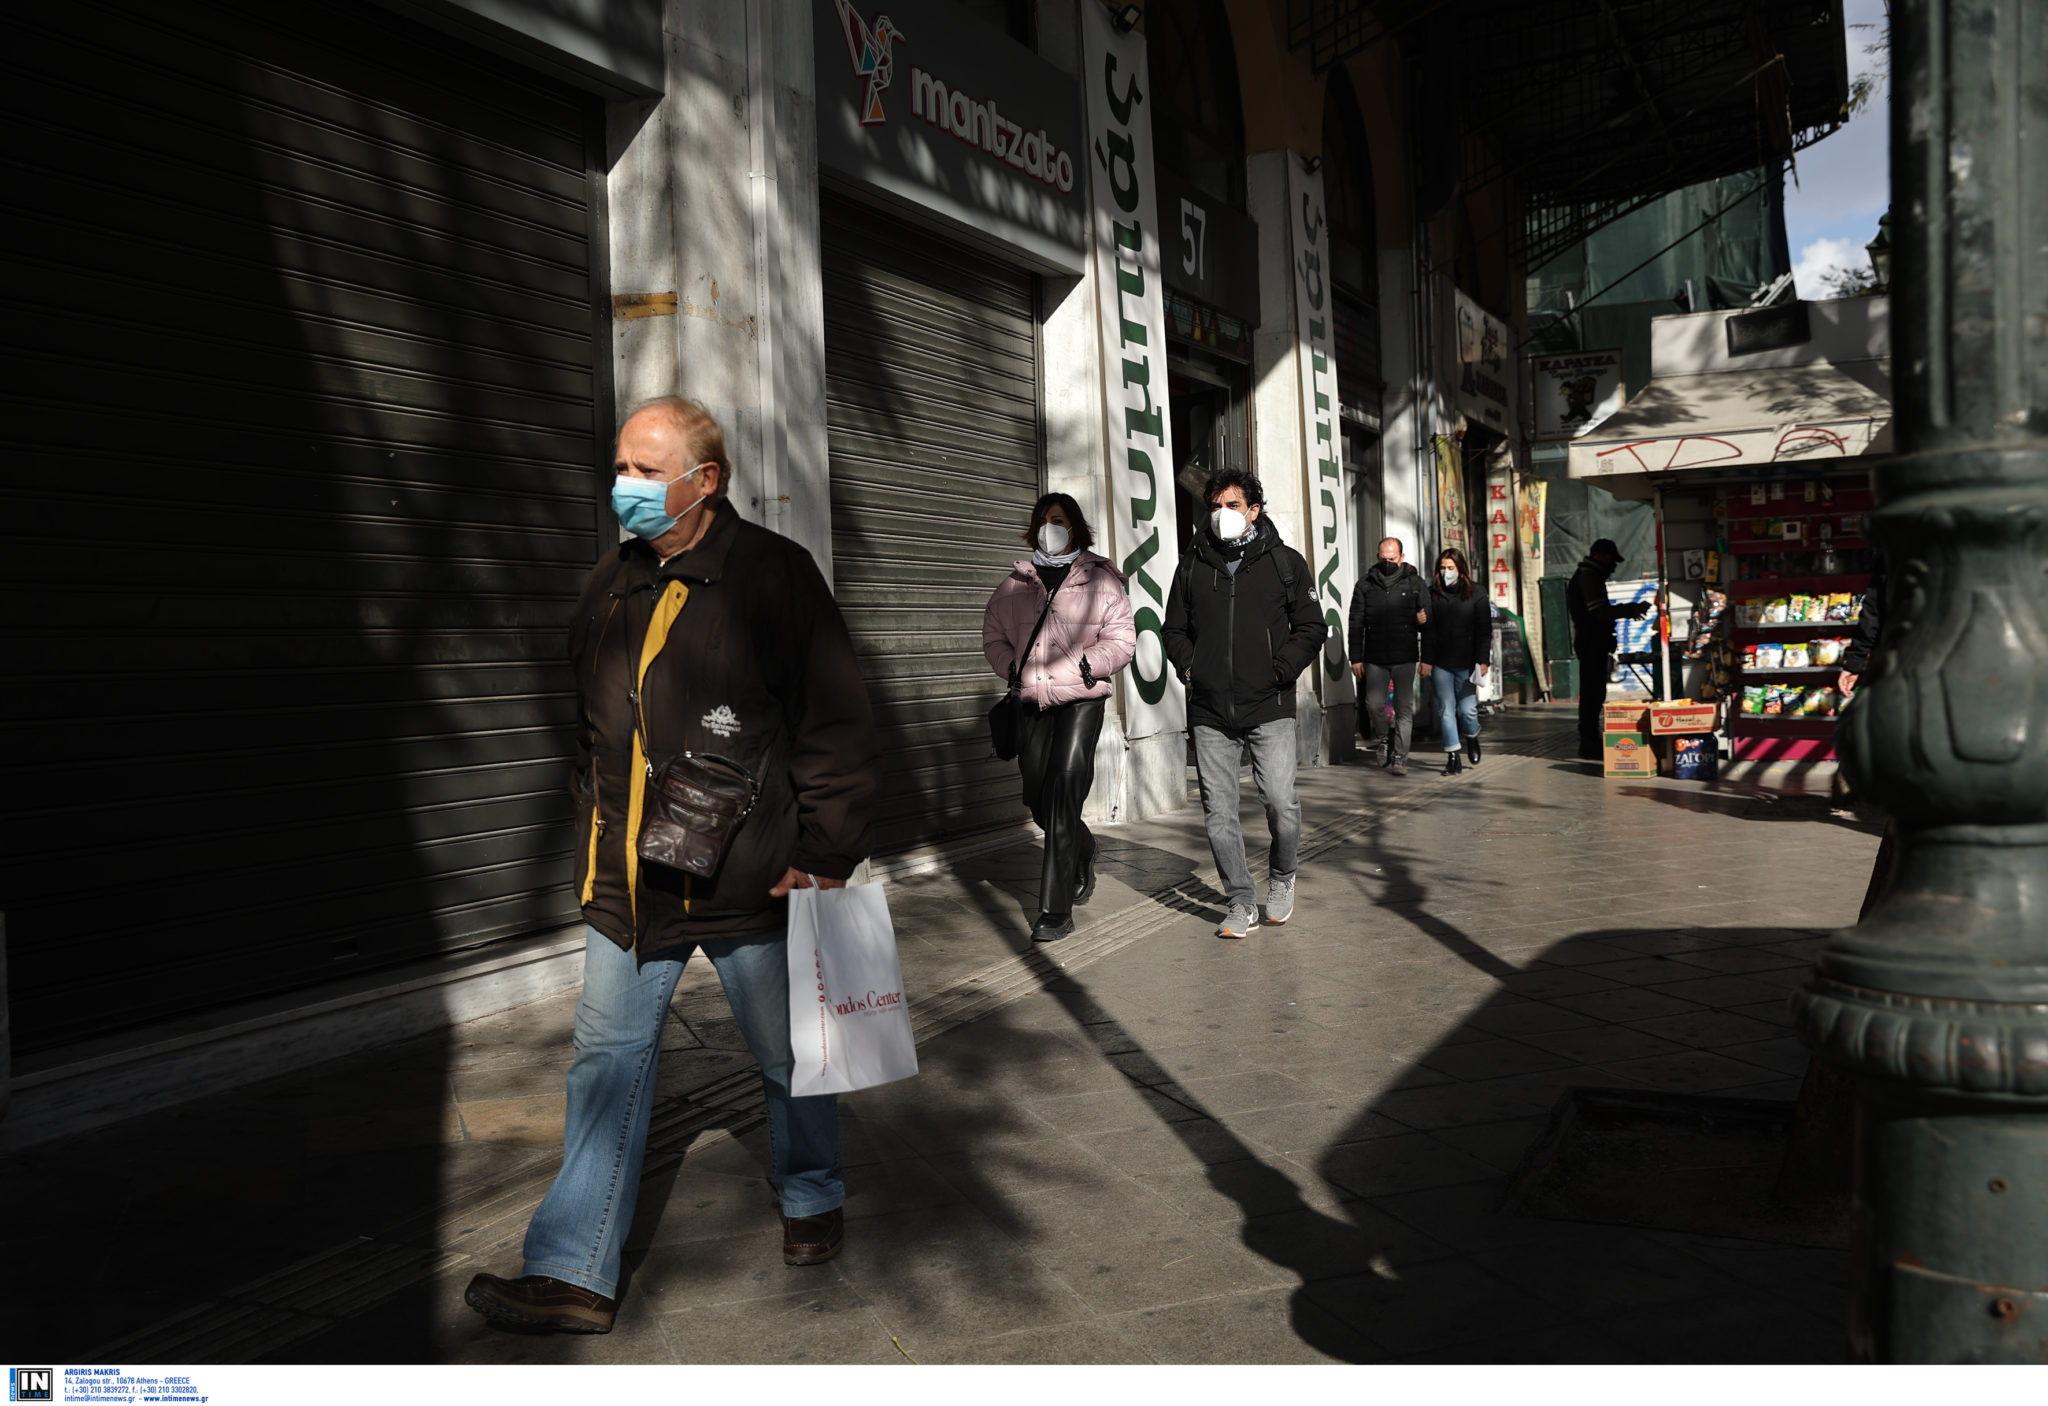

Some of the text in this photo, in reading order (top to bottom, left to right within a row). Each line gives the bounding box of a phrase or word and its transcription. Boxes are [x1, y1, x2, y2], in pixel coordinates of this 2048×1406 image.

[911, 66, 1074, 193] mantzato
[1181, 197, 1206, 280] 57
[867, 990, 901, 1008] Center
